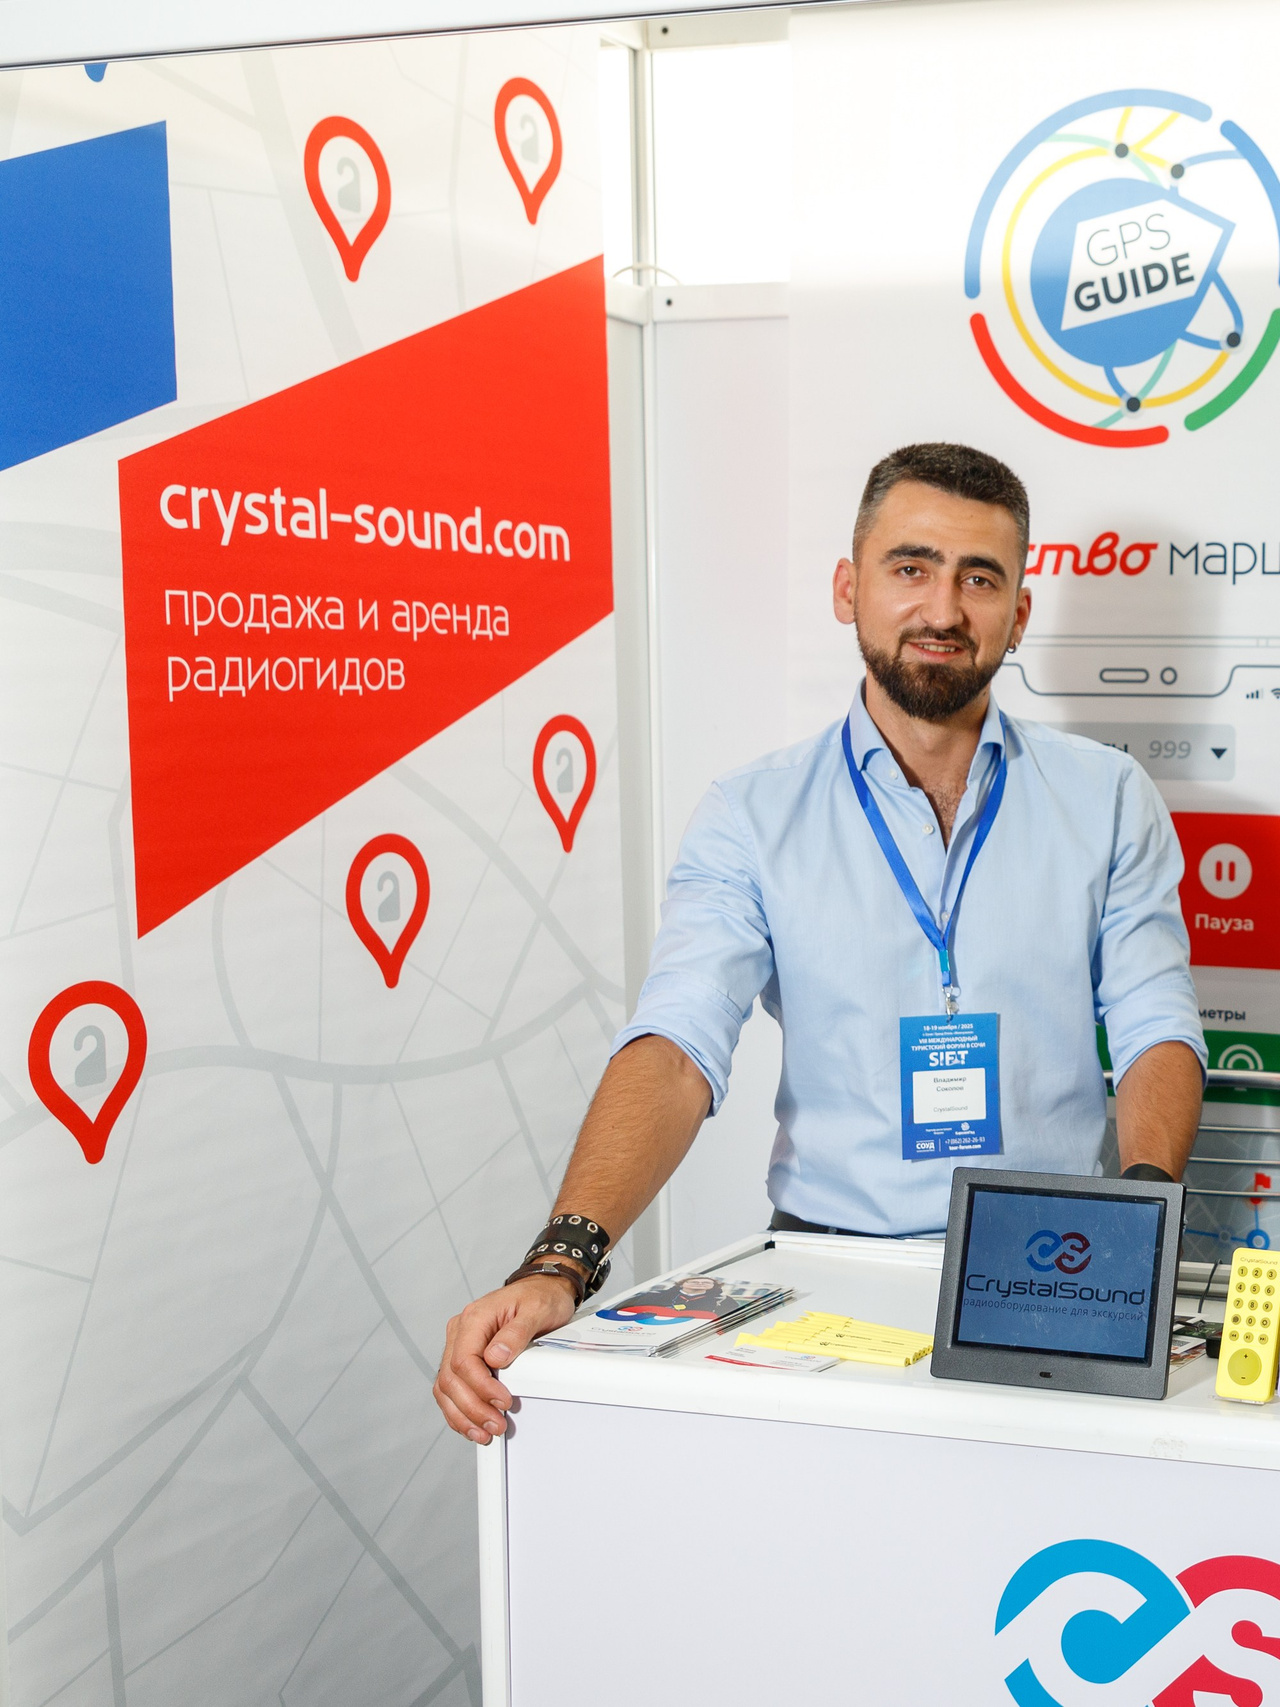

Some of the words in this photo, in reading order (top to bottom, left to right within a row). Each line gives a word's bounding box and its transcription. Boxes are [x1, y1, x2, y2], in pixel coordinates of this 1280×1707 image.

[1086, 212, 1172, 267] GPS
[1073, 251, 1196, 314] GUIDE
[159, 483, 571, 562] crystal-sound.com
[164, 588, 345, 635] продажа
[357, 597, 379, 631] и
[391, 597, 511, 641] аренда
[167, 654, 406, 702] радиогидов
[1148, 740, 1192, 759] 999
[1194, 913, 1255, 934] Пауза
[963, 1298, 1067, 1315] радиооборудование
[1070, 1307, 1088, 1317] для
[1091, 1309, 1144, 1321] экскурсий
[966, 1274, 1146, 1306] CrystalSound
